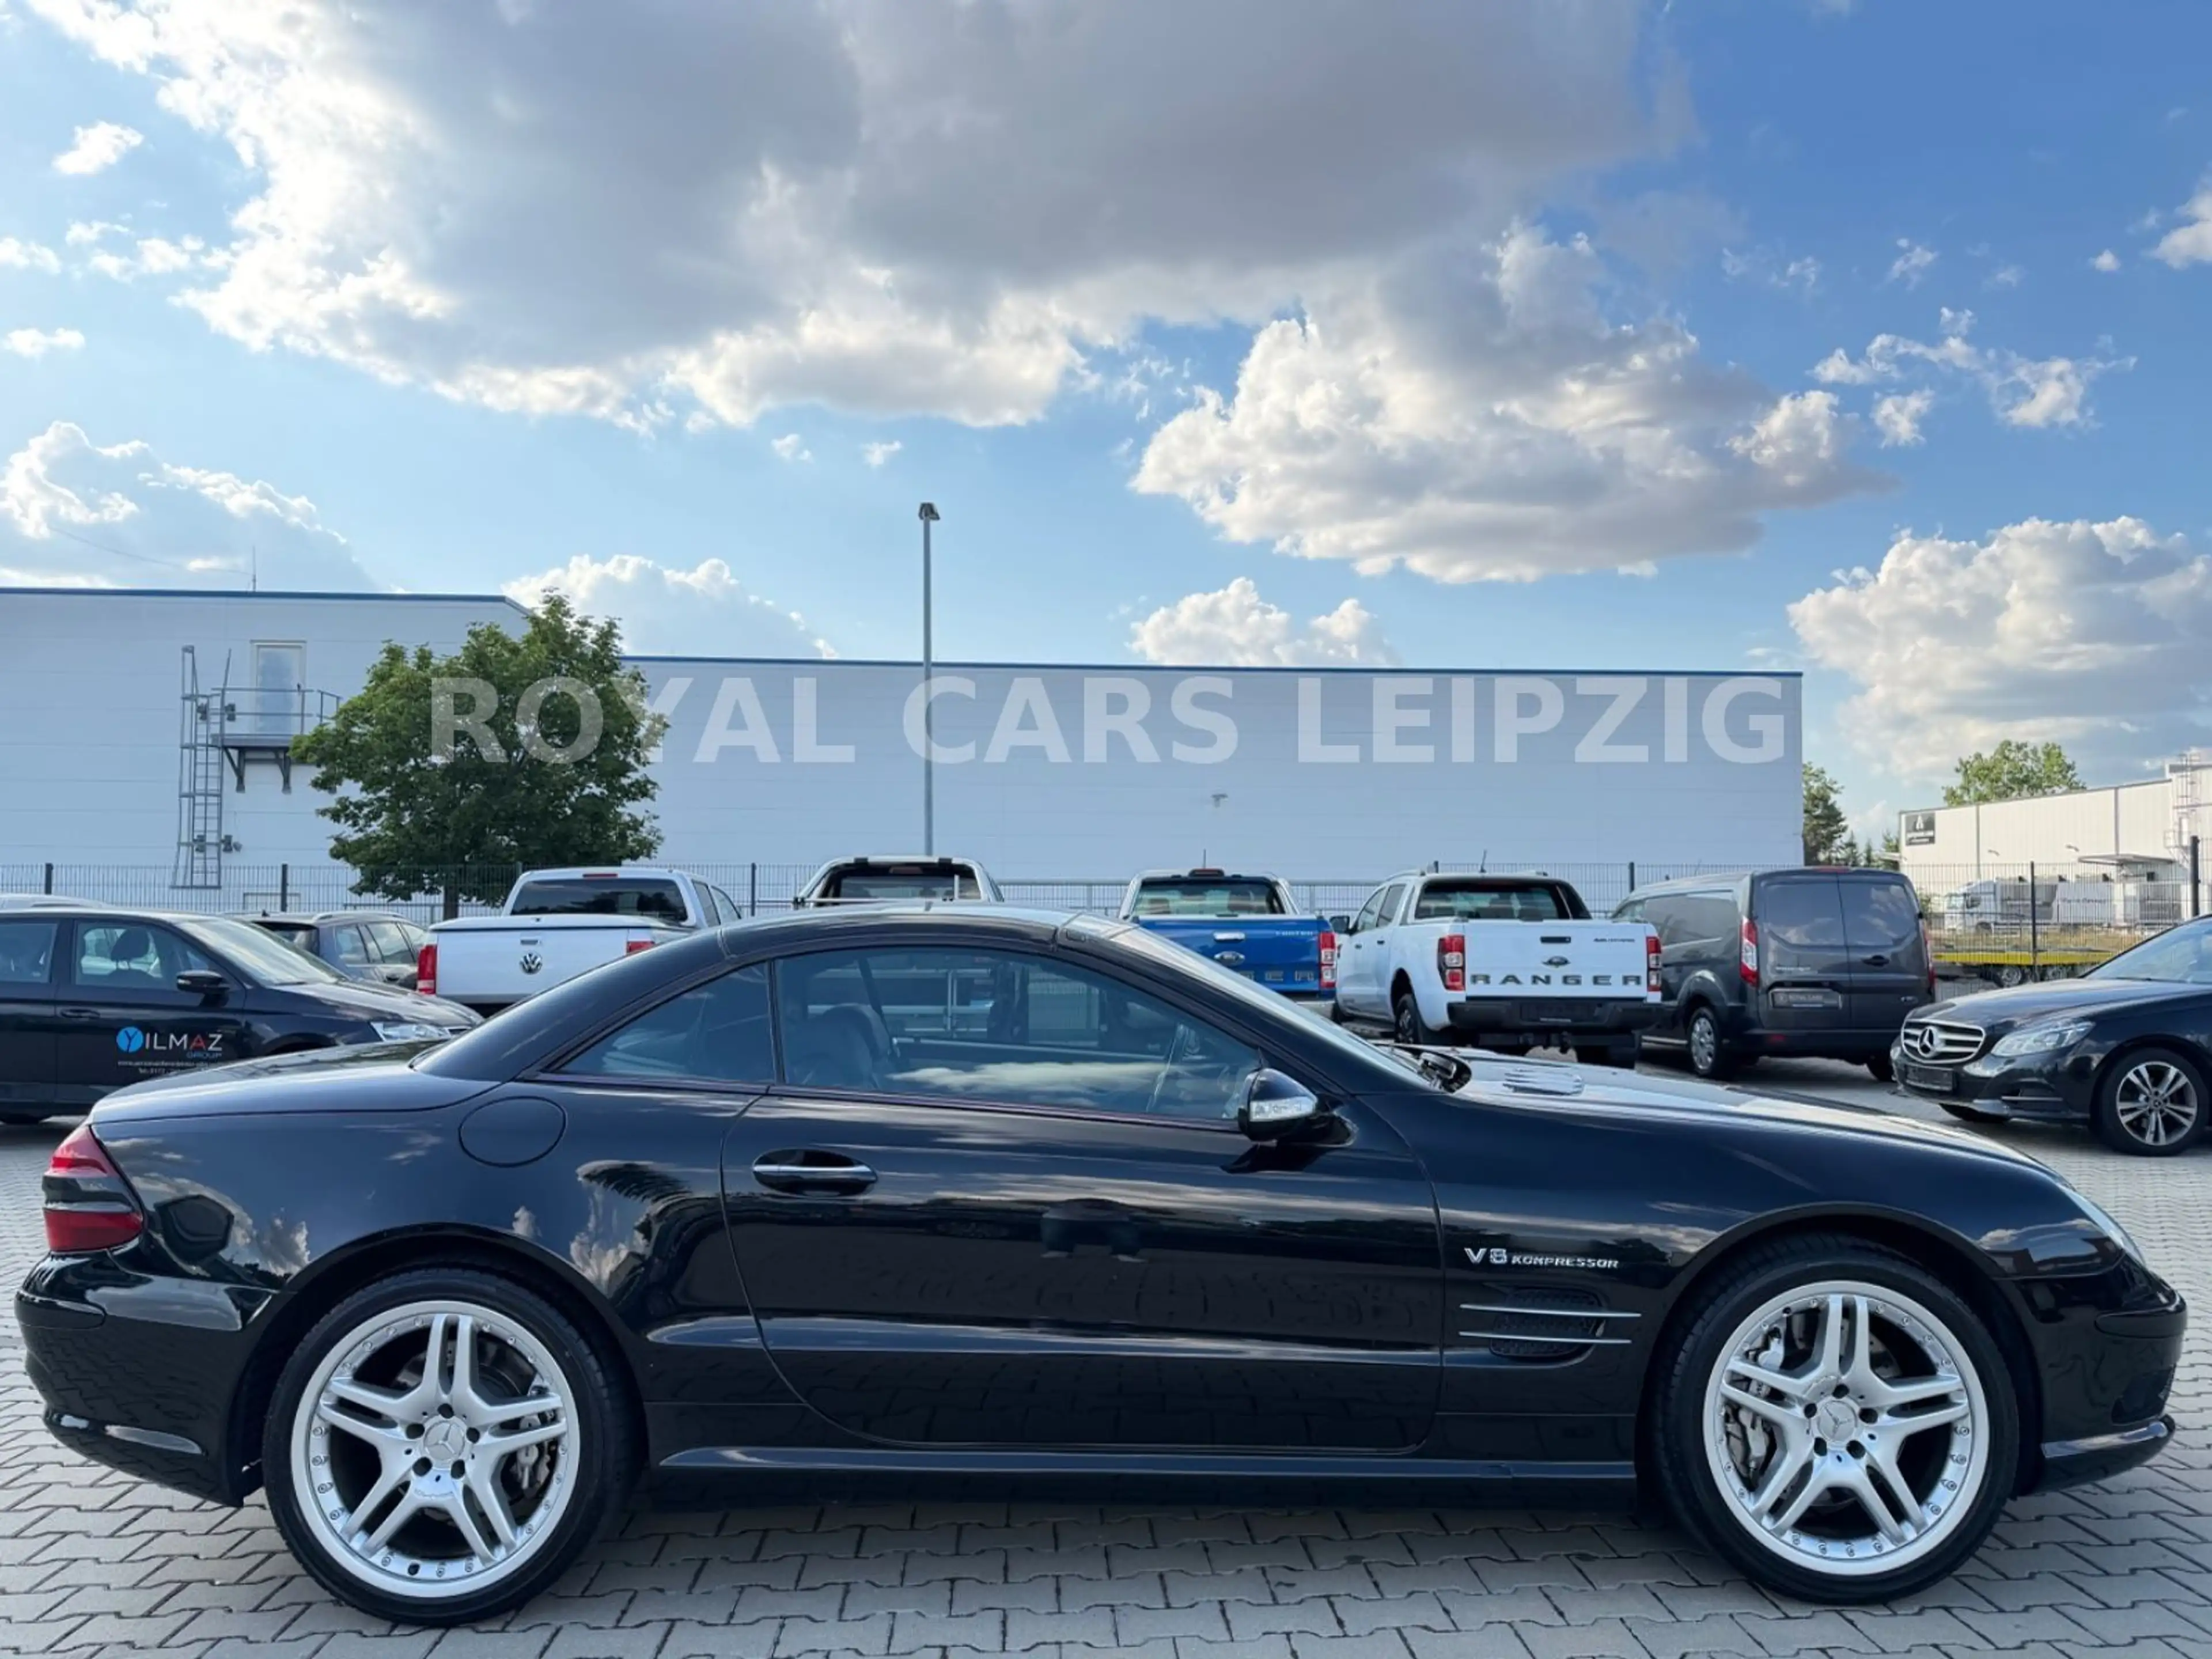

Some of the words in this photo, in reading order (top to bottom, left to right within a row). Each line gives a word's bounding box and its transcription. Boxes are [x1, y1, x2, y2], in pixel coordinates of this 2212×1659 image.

[1470, 974, 1642, 985] RANGER
[116, 1027, 223, 1053] YILMAZ
[1464, 1248, 1507, 1264] V8
[1511, 1255, 1619, 1268] KOMPRESSOR
